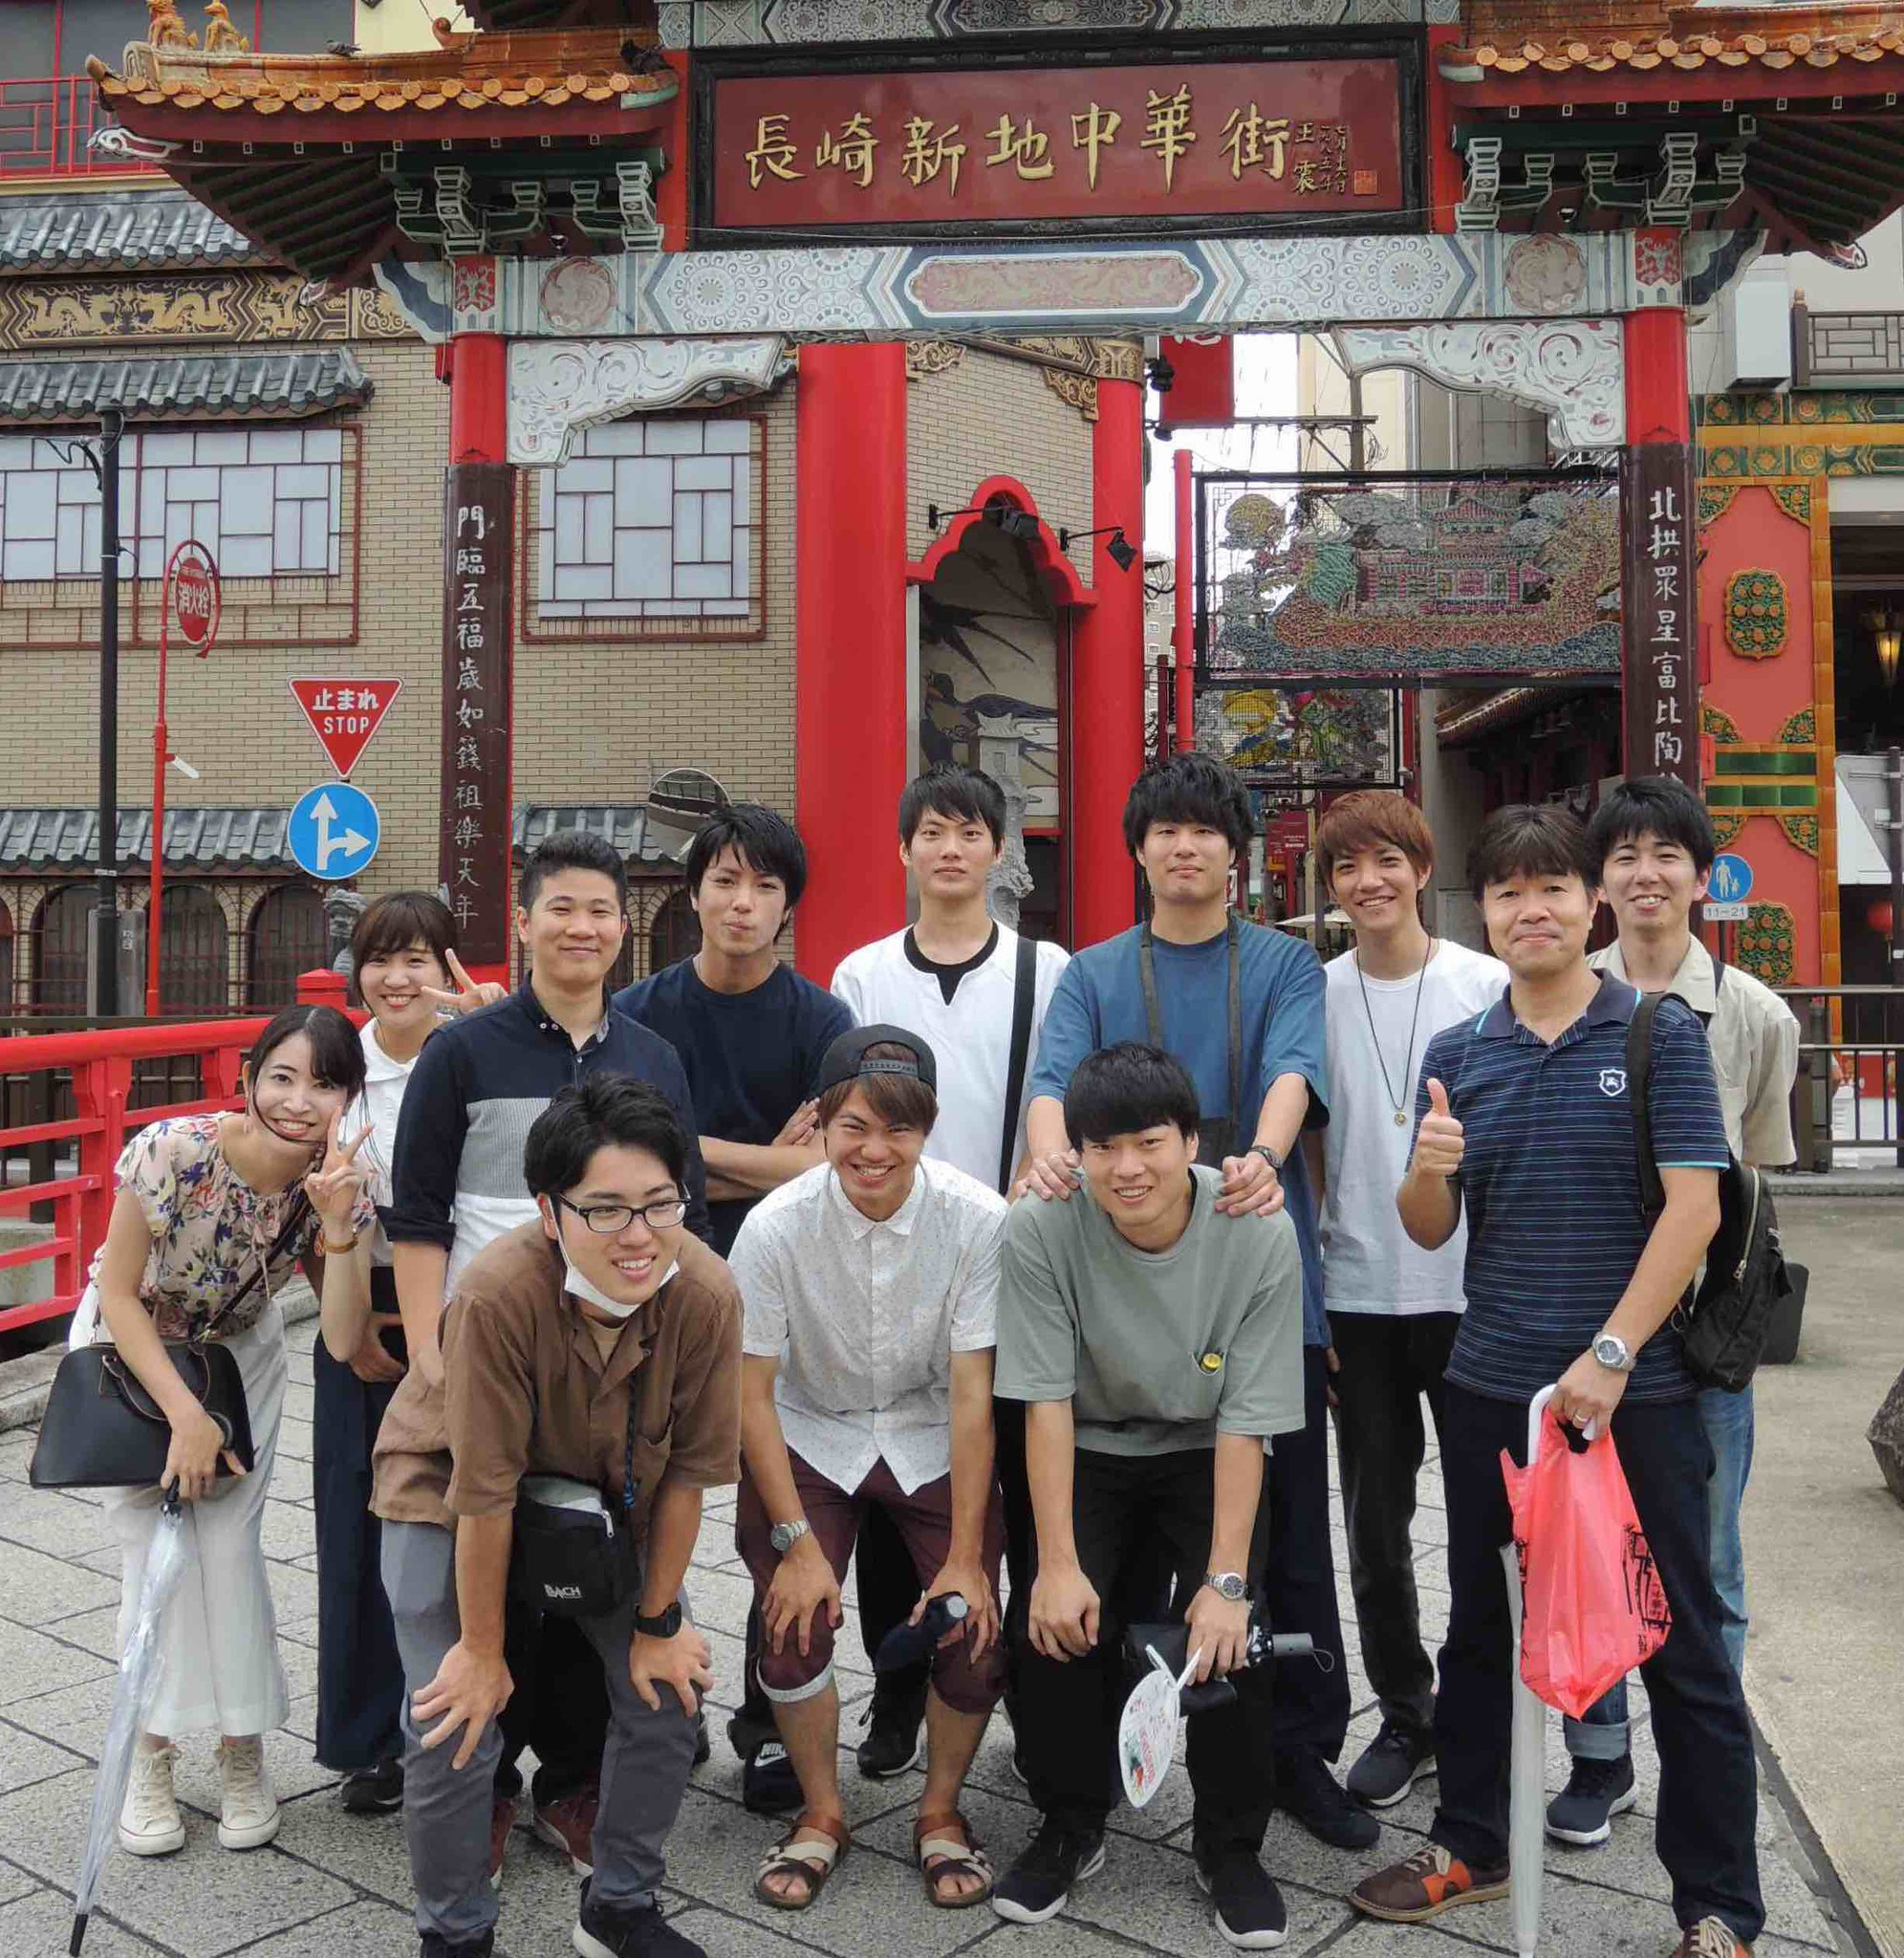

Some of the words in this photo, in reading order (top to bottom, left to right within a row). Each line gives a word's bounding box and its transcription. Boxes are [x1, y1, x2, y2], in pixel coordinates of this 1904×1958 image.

[745, 83, 1290, 197] 長崎新地中華街
[178, 582, 210, 619] 消火栓
[312, 687, 379, 710] 止まれ
[323, 715, 370, 734] STOP
[543, 1583, 582, 1599] BACH
